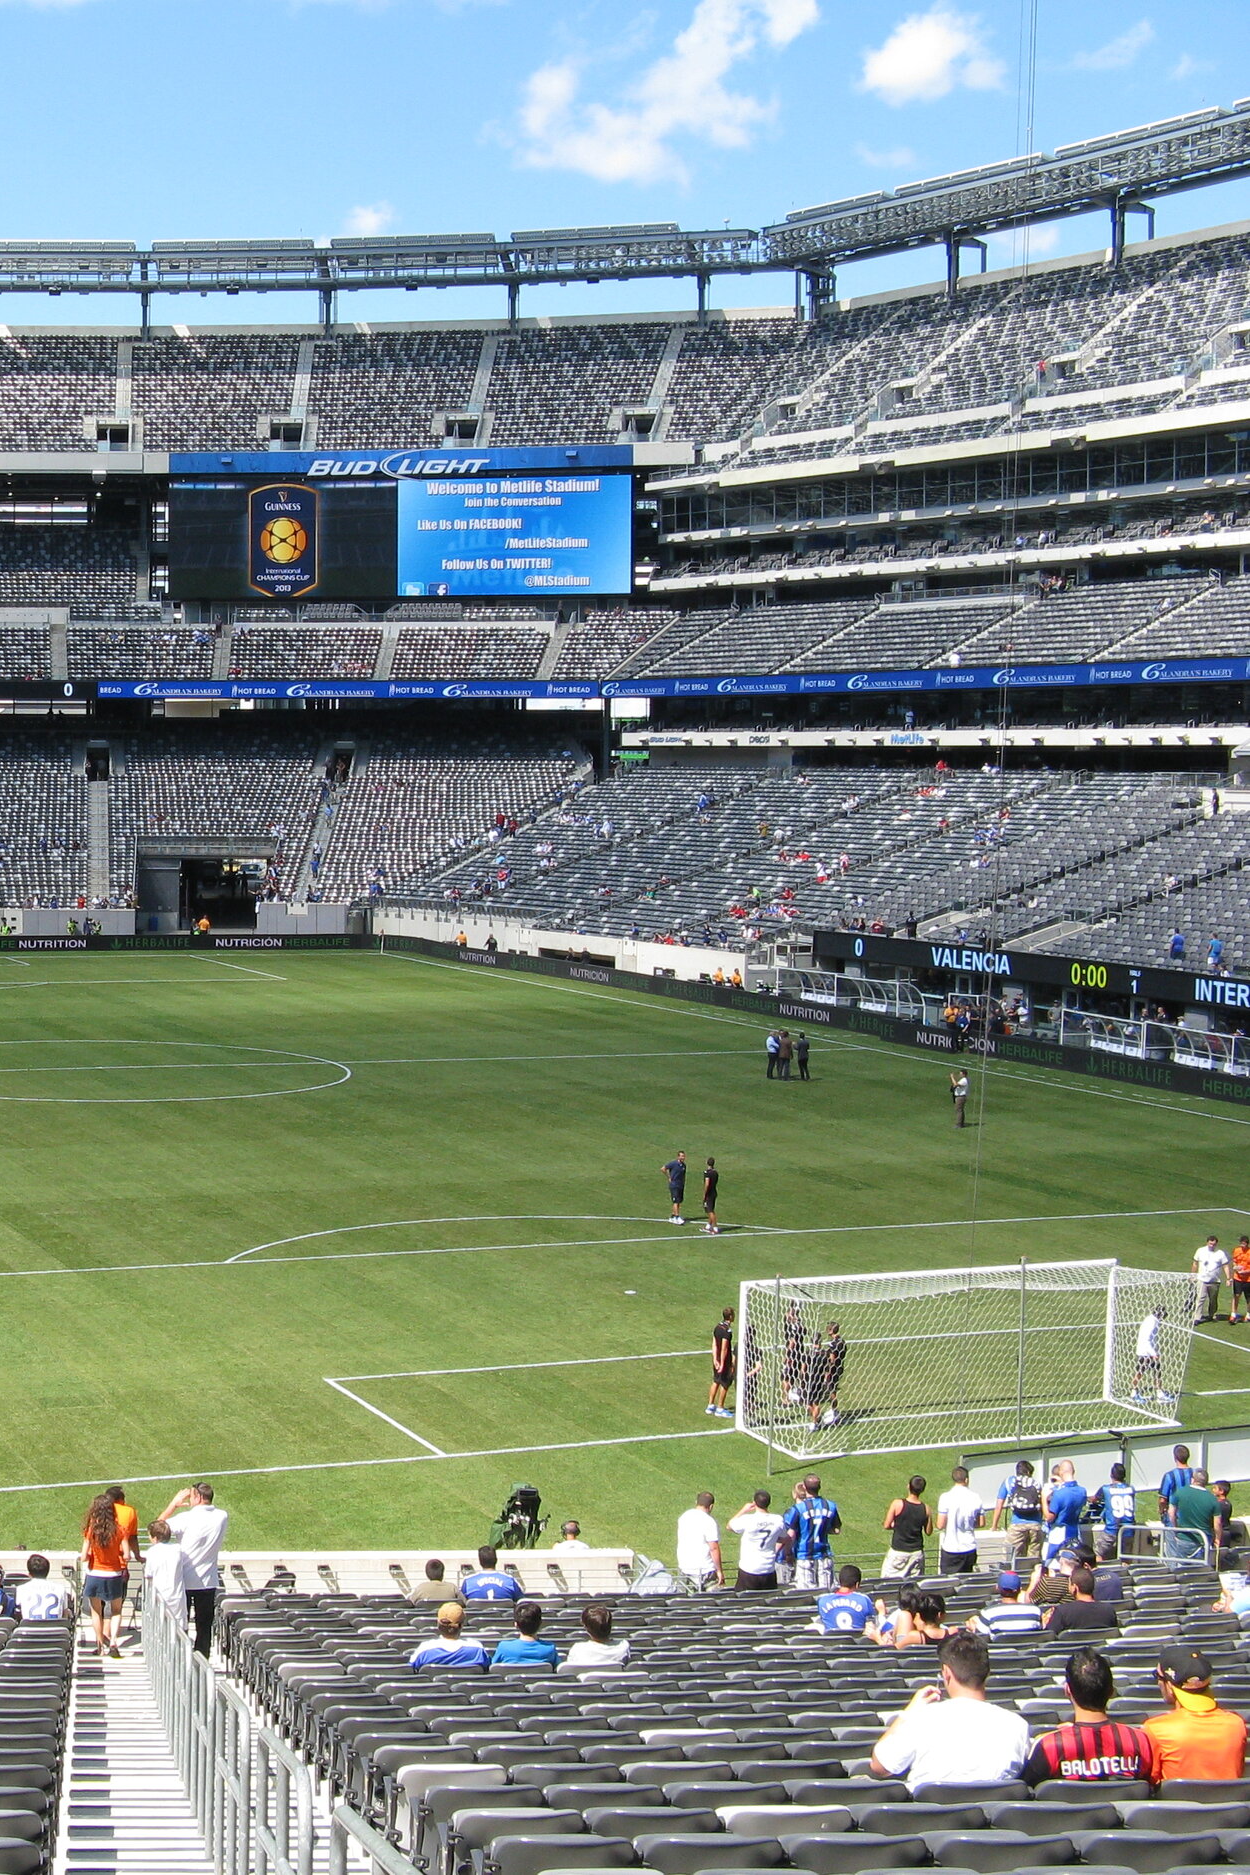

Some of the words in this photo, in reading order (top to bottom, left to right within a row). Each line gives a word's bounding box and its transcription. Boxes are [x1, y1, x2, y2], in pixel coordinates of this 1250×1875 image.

[306, 459, 378, 476] BUD
[397, 458, 491, 475] LIGHT
[426, 480, 483, 496] Welcome
[485, 481, 498, 494] to
[545, 478, 601, 493] Stadium!
[264, 501, 301, 511] GUINNESS
[464, 497, 482, 508] Join
[484, 496, 499, 507] the
[500, 496, 562, 507] Conversation
[417, 519, 438, 531] Like
[439, 519, 452, 531] Us
[453, 519, 467, 530] On
[469, 517, 522, 530] FACEBOOK!
[505, 537, 590, 550] /MetLifeStadium
[265, 567, 301, 575] International
[441, 558, 475, 571] Follow
[476, 558, 489, 570] Us
[490, 558, 504, 570] On
[505, 557, 553, 570] TWITTER!
[256, 573, 295, 582] CHAMPIONS
[295, 573, 312, 581] CUP
[524, 575, 591, 588] @MLStadium
[274, 584, 292, 593] 2013
[941, 675, 953, 684] HOT
[954, 674, 975, 684] BREAD
[1095, 670, 1109, 679] HOT
[1110, 669, 1132, 680] BREAD
[63, 683, 74, 697] 0
[395, 686, 411, 695] HOT
[411, 686, 435, 695] BREAD
[553, 686, 568, 694] HOT
[568, 685, 591, 694] BREAD
[679, 683, 691, 691] HOT
[691, 682, 709, 692] BREAD
[804, 680, 816, 688] HOT
[817, 679, 836, 688] BREAD
[238, 687, 253, 695] HOT
[253, 687, 277, 695] BREAD
[18, 939, 87, 948] NUTRITION
[125, 937, 191, 947] HERBALIFE
[215, 936, 283, 947] NUTRICIÓN
[284, 937, 350, 947] HERBALIFE
[854, 938, 864, 957] 0
[459, 951, 497, 965] NUTRITION
[931, 947, 1011, 976] VALENCIA
[570, 967, 610, 983] NUTRICIÓN
[1071, 962, 1107, 989] 0:00
[1130, 979, 1137, 994] 1
[1195, 978, 1250, 1007] INTER
[779, 1003, 830, 1023] NUTRITION
[997, 1042, 1064, 1065] HERBALIFE
[1101, 1058, 1172, 1086] HERBALIFE
[1110, 1493, 1135, 1519] 99
[813, 1518, 823, 1543] 7
[758, 1529, 772, 1549] 7
[28, 1593, 61, 1619] 22
[1060, 1755, 1140, 1776] BALOTELLI
